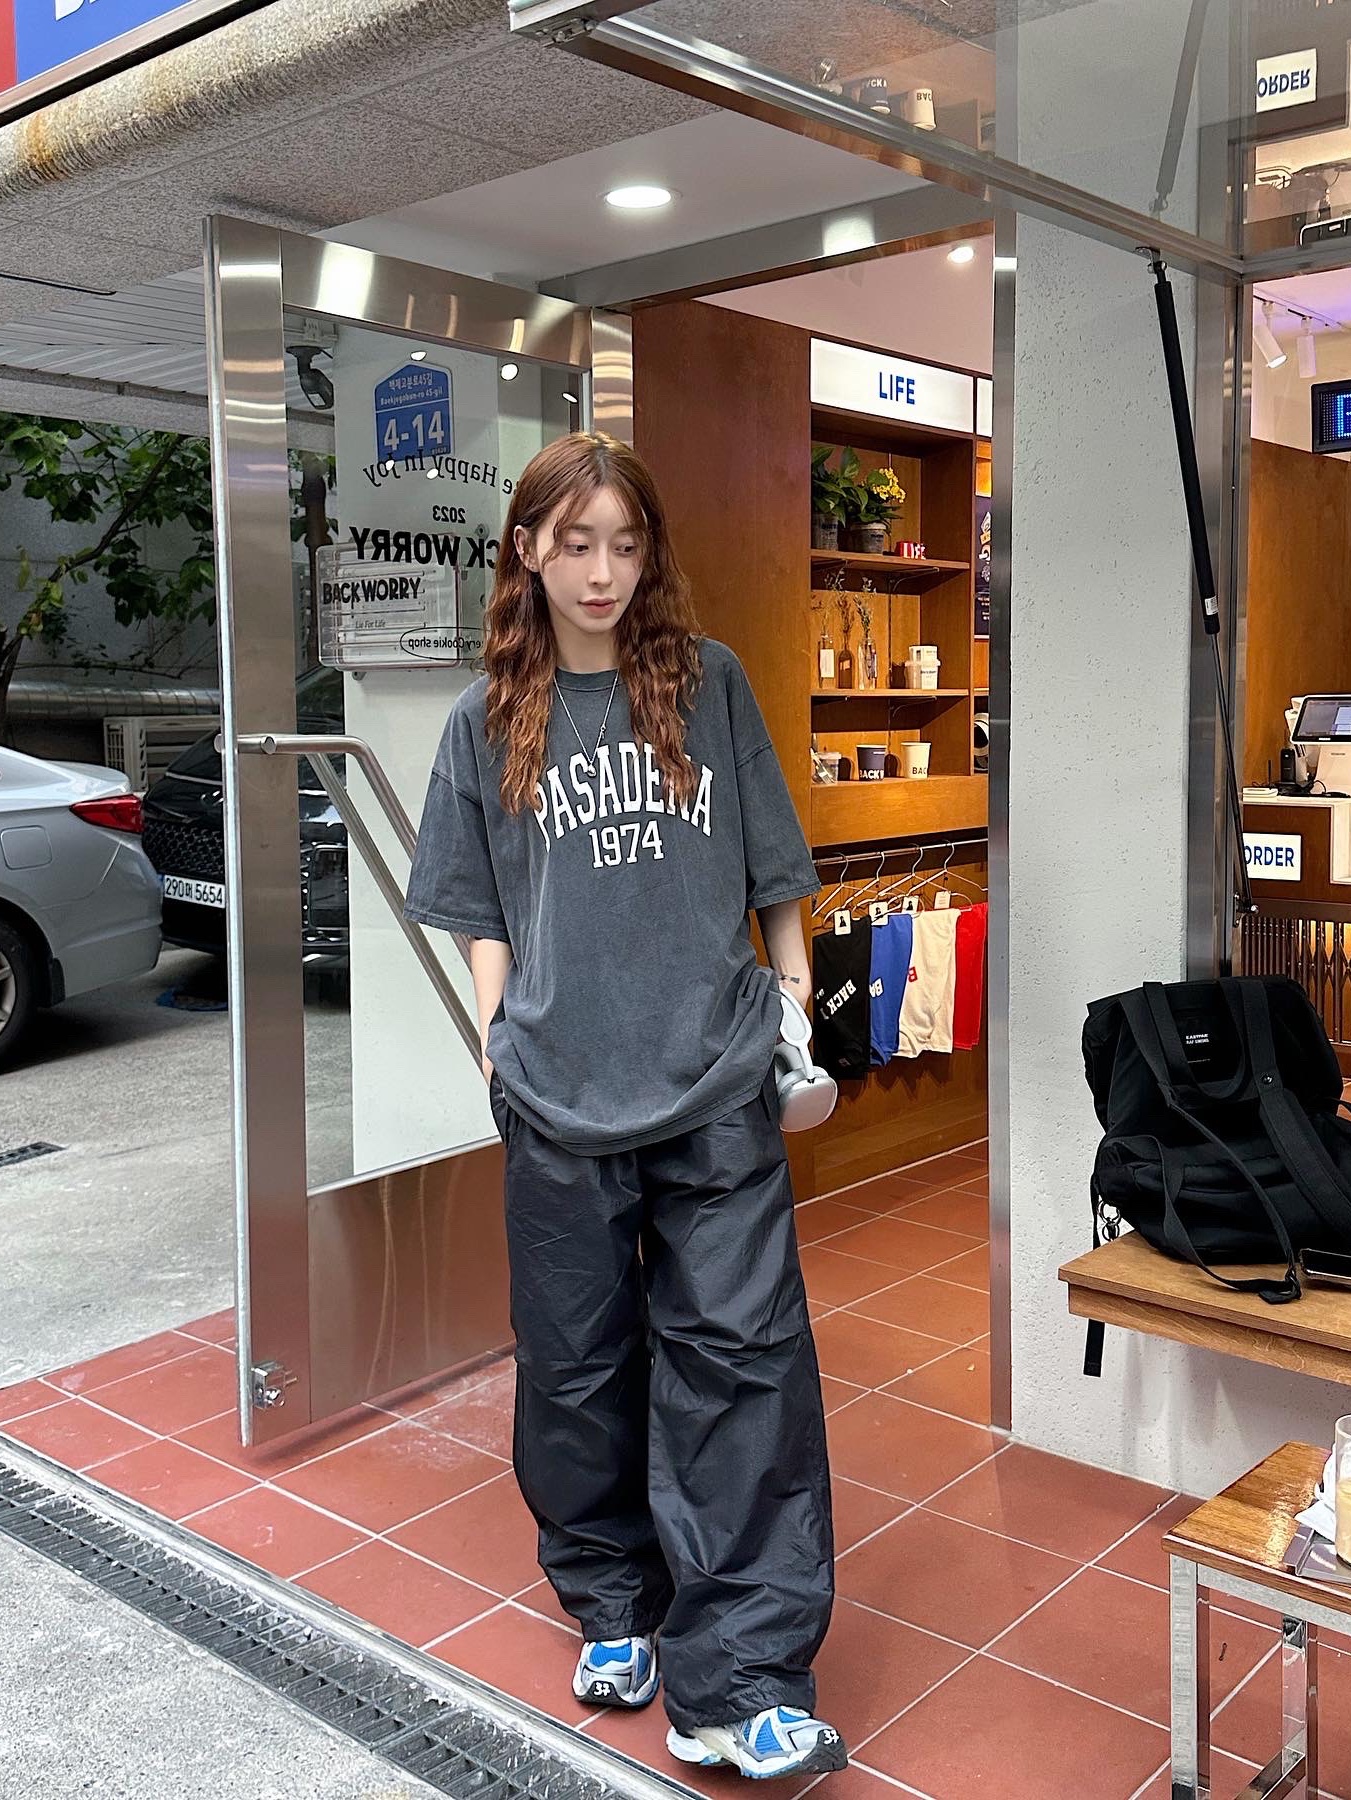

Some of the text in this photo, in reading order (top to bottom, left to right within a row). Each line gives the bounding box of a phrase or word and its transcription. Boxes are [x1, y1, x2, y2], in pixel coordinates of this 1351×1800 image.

[879, 371, 916, 405] LIFE
[383, 410, 445, 451] 4-14
[902, 541, 927, 560] LIFE
[588, 819, 665, 869] 1974
[1244, 845, 1295, 868] ORDER
[195, 883, 223, 905] 5654
